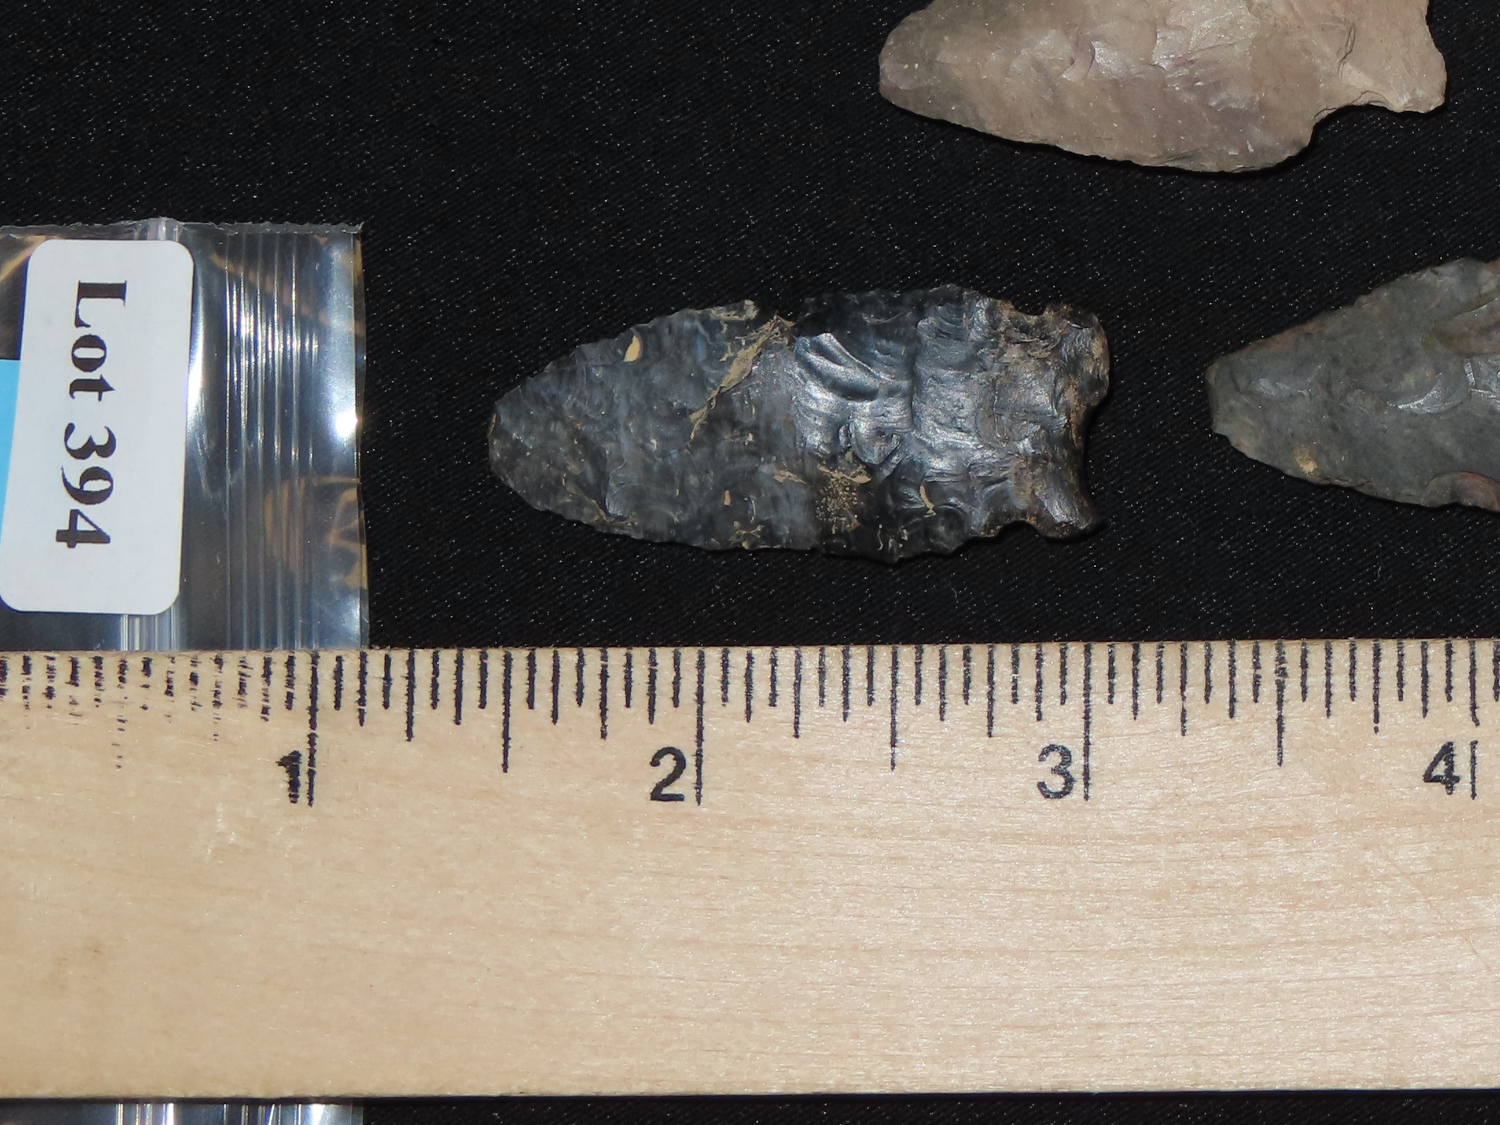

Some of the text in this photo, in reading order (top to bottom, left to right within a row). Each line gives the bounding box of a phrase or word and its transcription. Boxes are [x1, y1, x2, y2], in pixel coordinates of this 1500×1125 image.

[55, 279, 128, 549] Lot 394
[649, 746, 687, 802] 2
[1037, 744, 1076, 799] 3
[1422, 741, 1459, 795] 4
